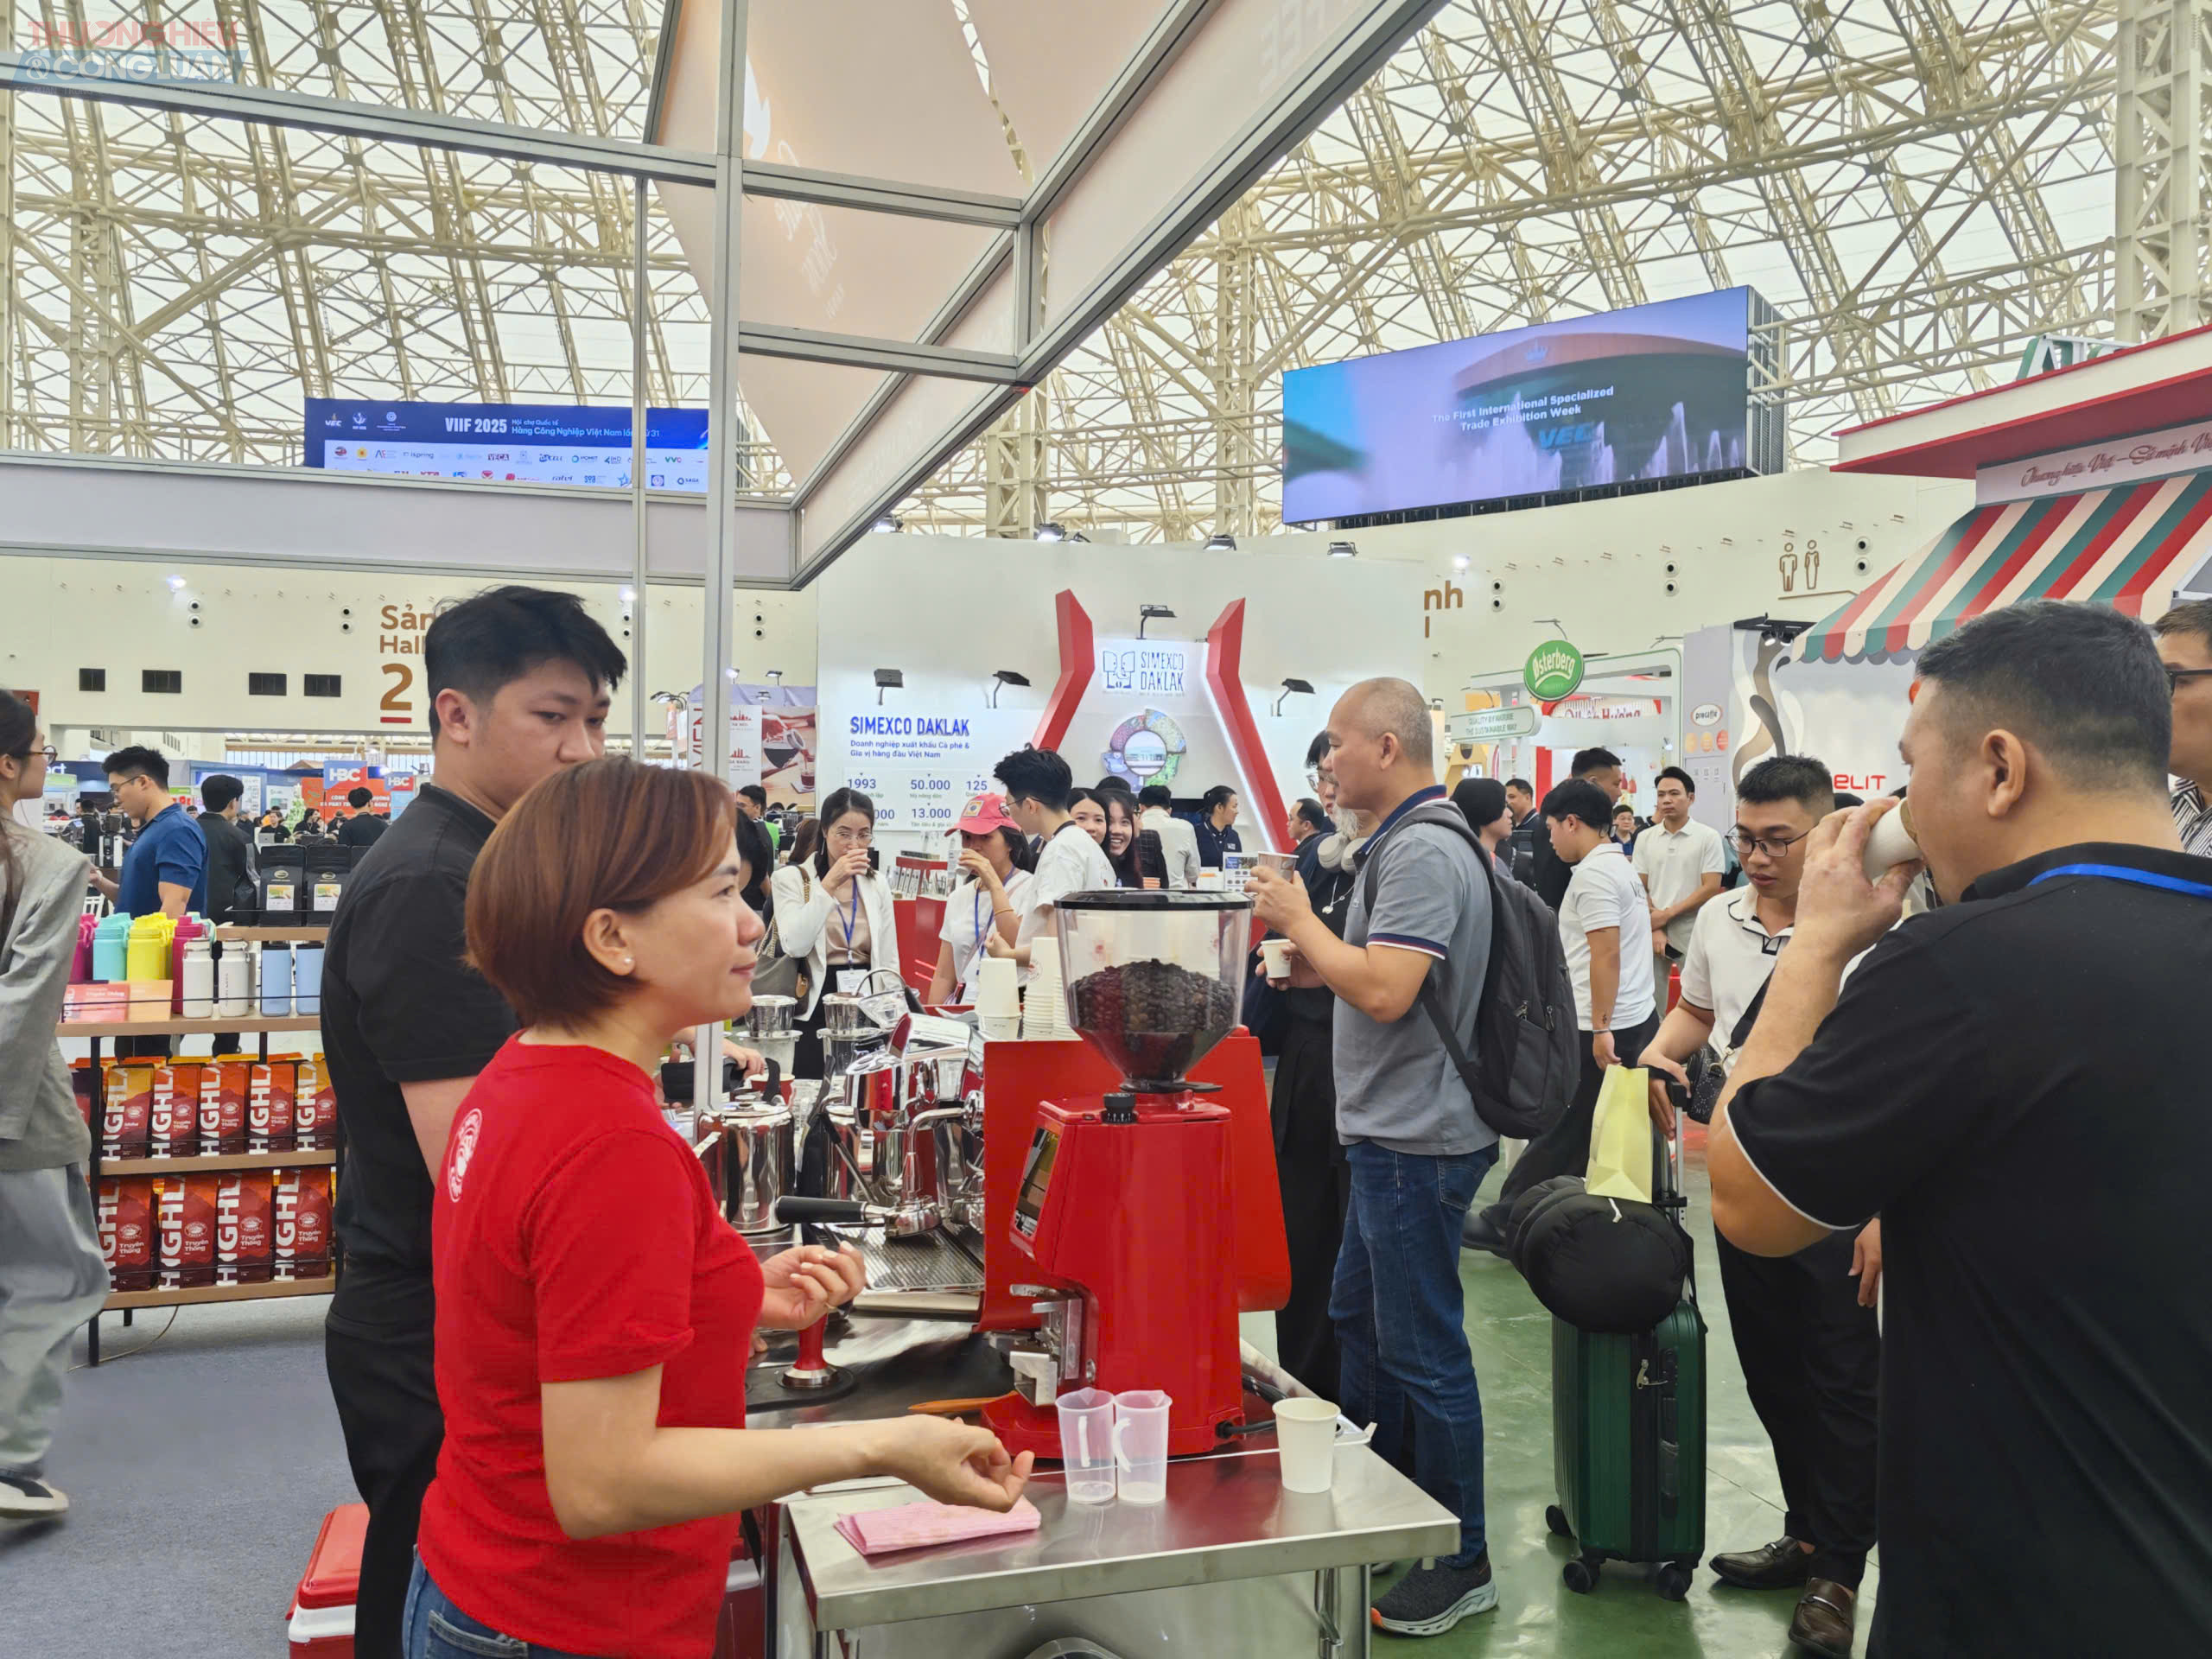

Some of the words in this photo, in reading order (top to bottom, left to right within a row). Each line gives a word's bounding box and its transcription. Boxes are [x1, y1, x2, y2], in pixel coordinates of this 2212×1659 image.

[1433, 414, 1450, 423] The
[1453, 409, 1477, 421] First
[1479, 396, 1548, 416] International
[1550, 385, 1614, 405] Specialized
[445, 417, 472, 433] VIIF
[474, 418, 508, 433] 2025
[1461, 419, 1490, 432] Trade
[1493, 410, 1548, 426] Exhibition
[1550, 404, 1581, 417] Week
[512, 427, 533, 435] Hàng
[534, 427, 556, 436] Công
[556, 428, 585, 438] Nghiệp
[586, 428, 603, 438] Việt
[1424, 580, 1463, 610] nh
[380, 603, 435, 630] Sản
[1141, 651, 1184, 671] SIMEXCO
[1532, 647, 1576, 681] Østerberg
[380, 663, 413, 710] 2
[1141, 671, 1184, 691] DAKLAK
[850, 715, 912, 735] SIMEXCO
[917, 717, 970, 737] DAKLAK
[872, 750, 891, 759] hàng
[892, 749, 906, 758] đầu
[908, 750, 923, 759] Việt
[875, 741, 900, 749] nghiệp
[901, 740, 918, 748] xuất
[329, 767, 361, 782] HBC
[388, 777, 410, 786] HBC
[848, 779, 876, 789] 1993
[910, 779, 950, 791] 50.000
[966, 780, 988, 791] 125
[912, 808, 951, 818] 13.000
